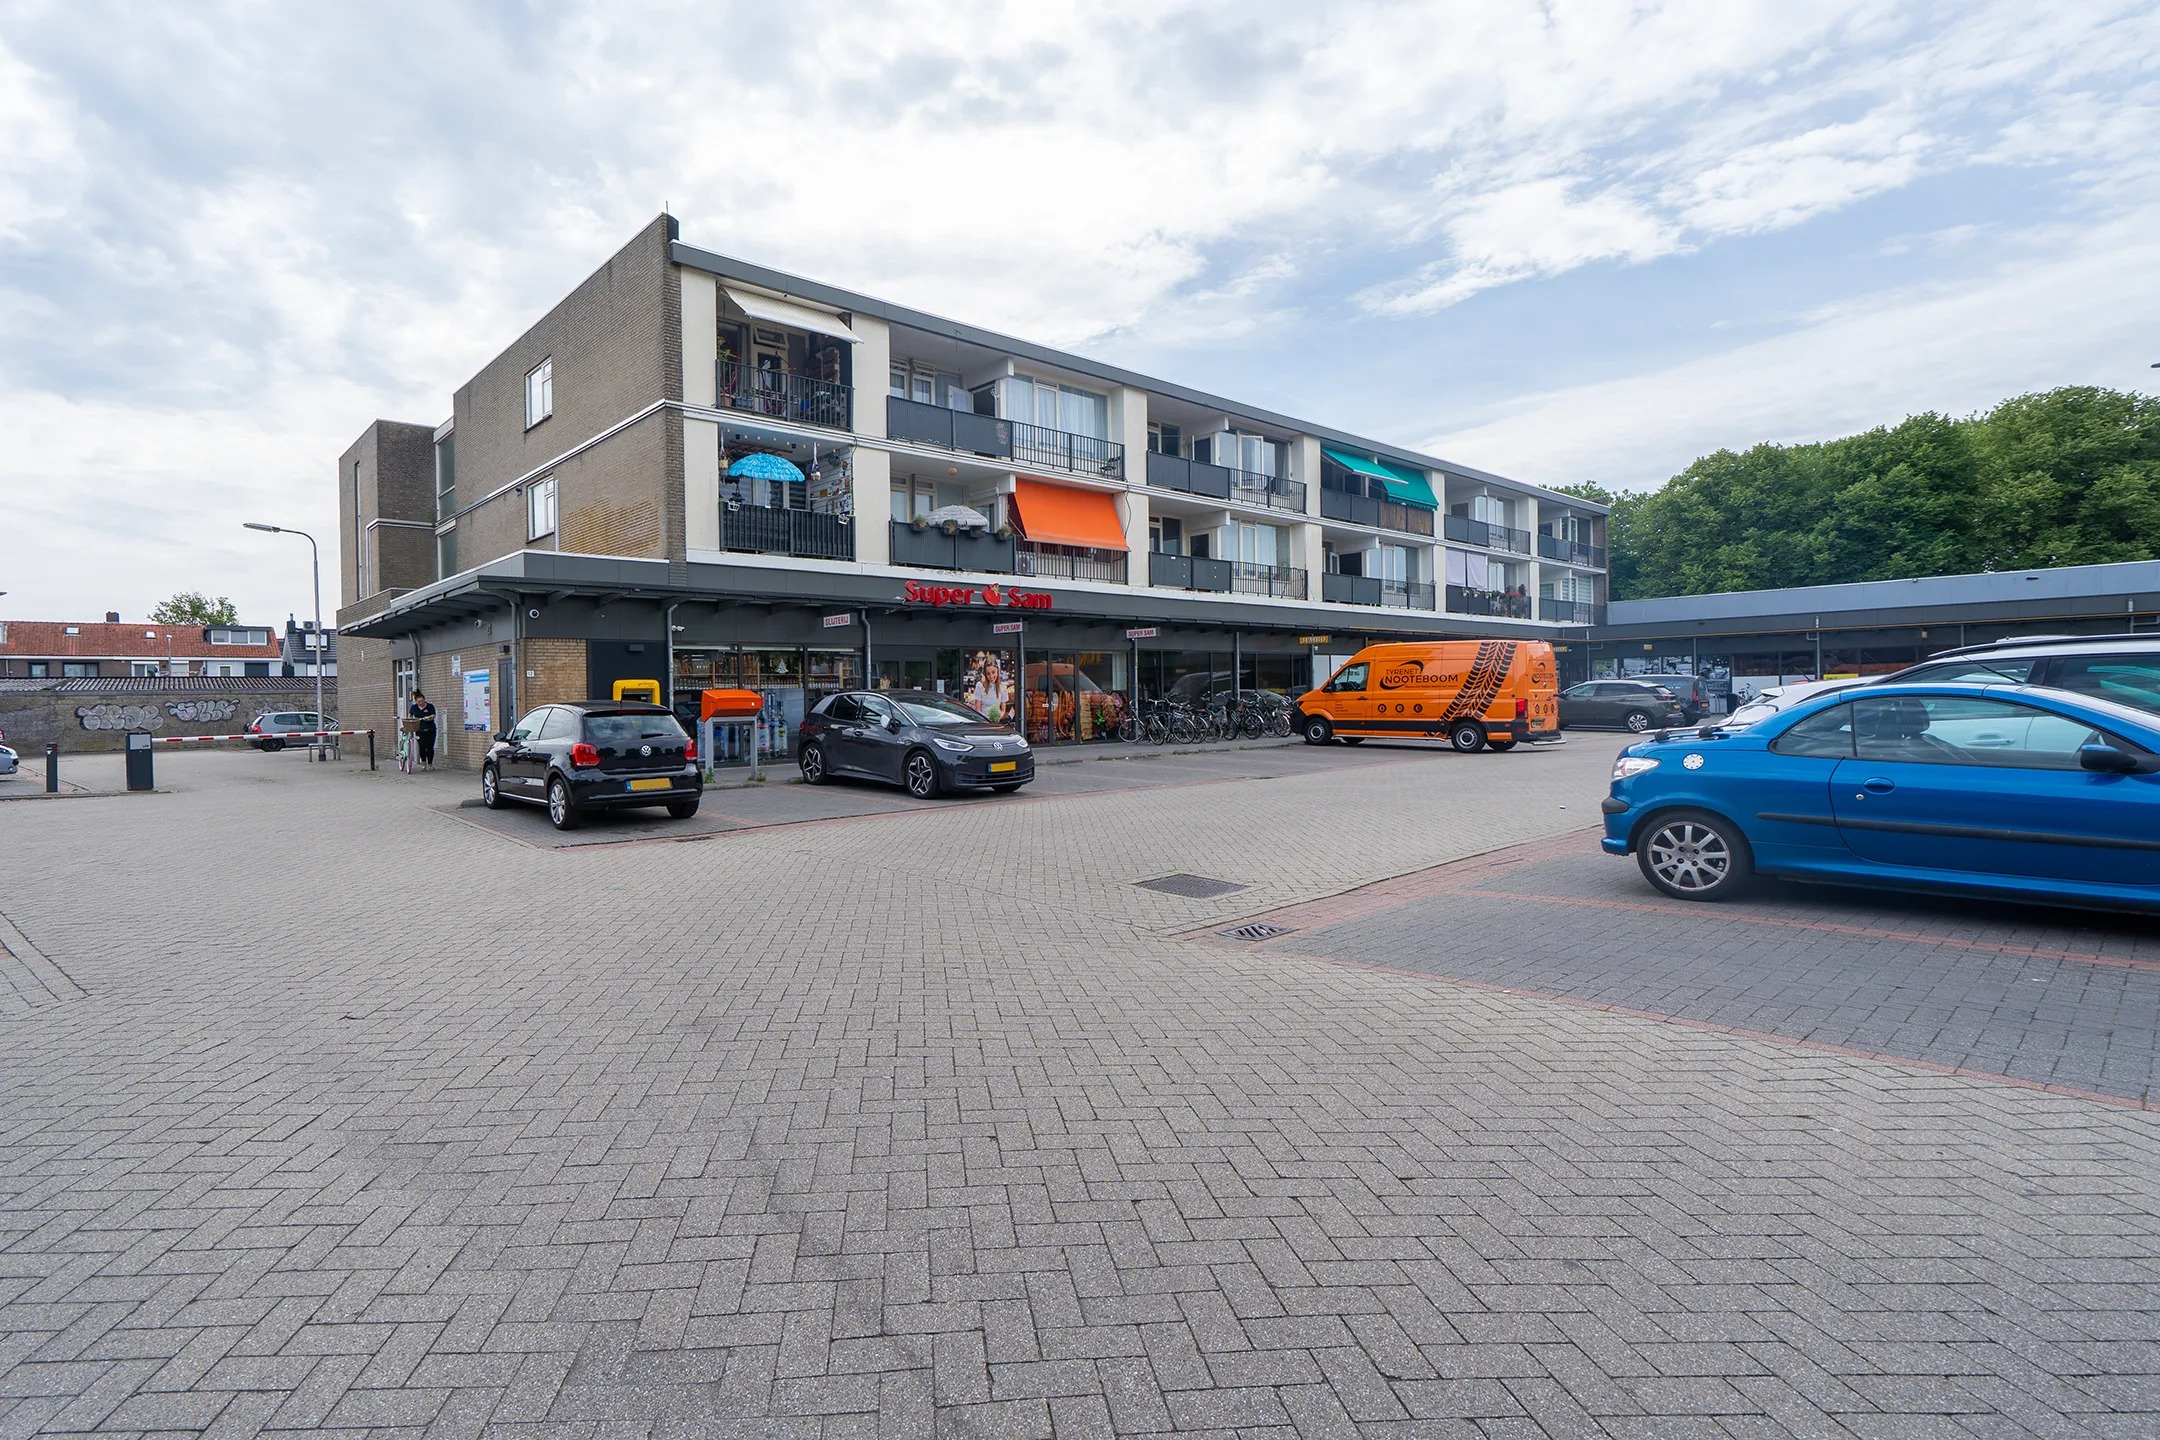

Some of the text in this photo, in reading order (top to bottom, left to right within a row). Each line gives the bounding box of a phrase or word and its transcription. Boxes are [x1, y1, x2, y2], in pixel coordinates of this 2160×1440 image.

[904, 579, 1053, 609] Super Sam
[824, 615, 849, 626] SLIJTERIJ
[995, 623, 1021, 633] SUPER SAM
[1385, 674, 1459, 684] NOOTEBOOM
